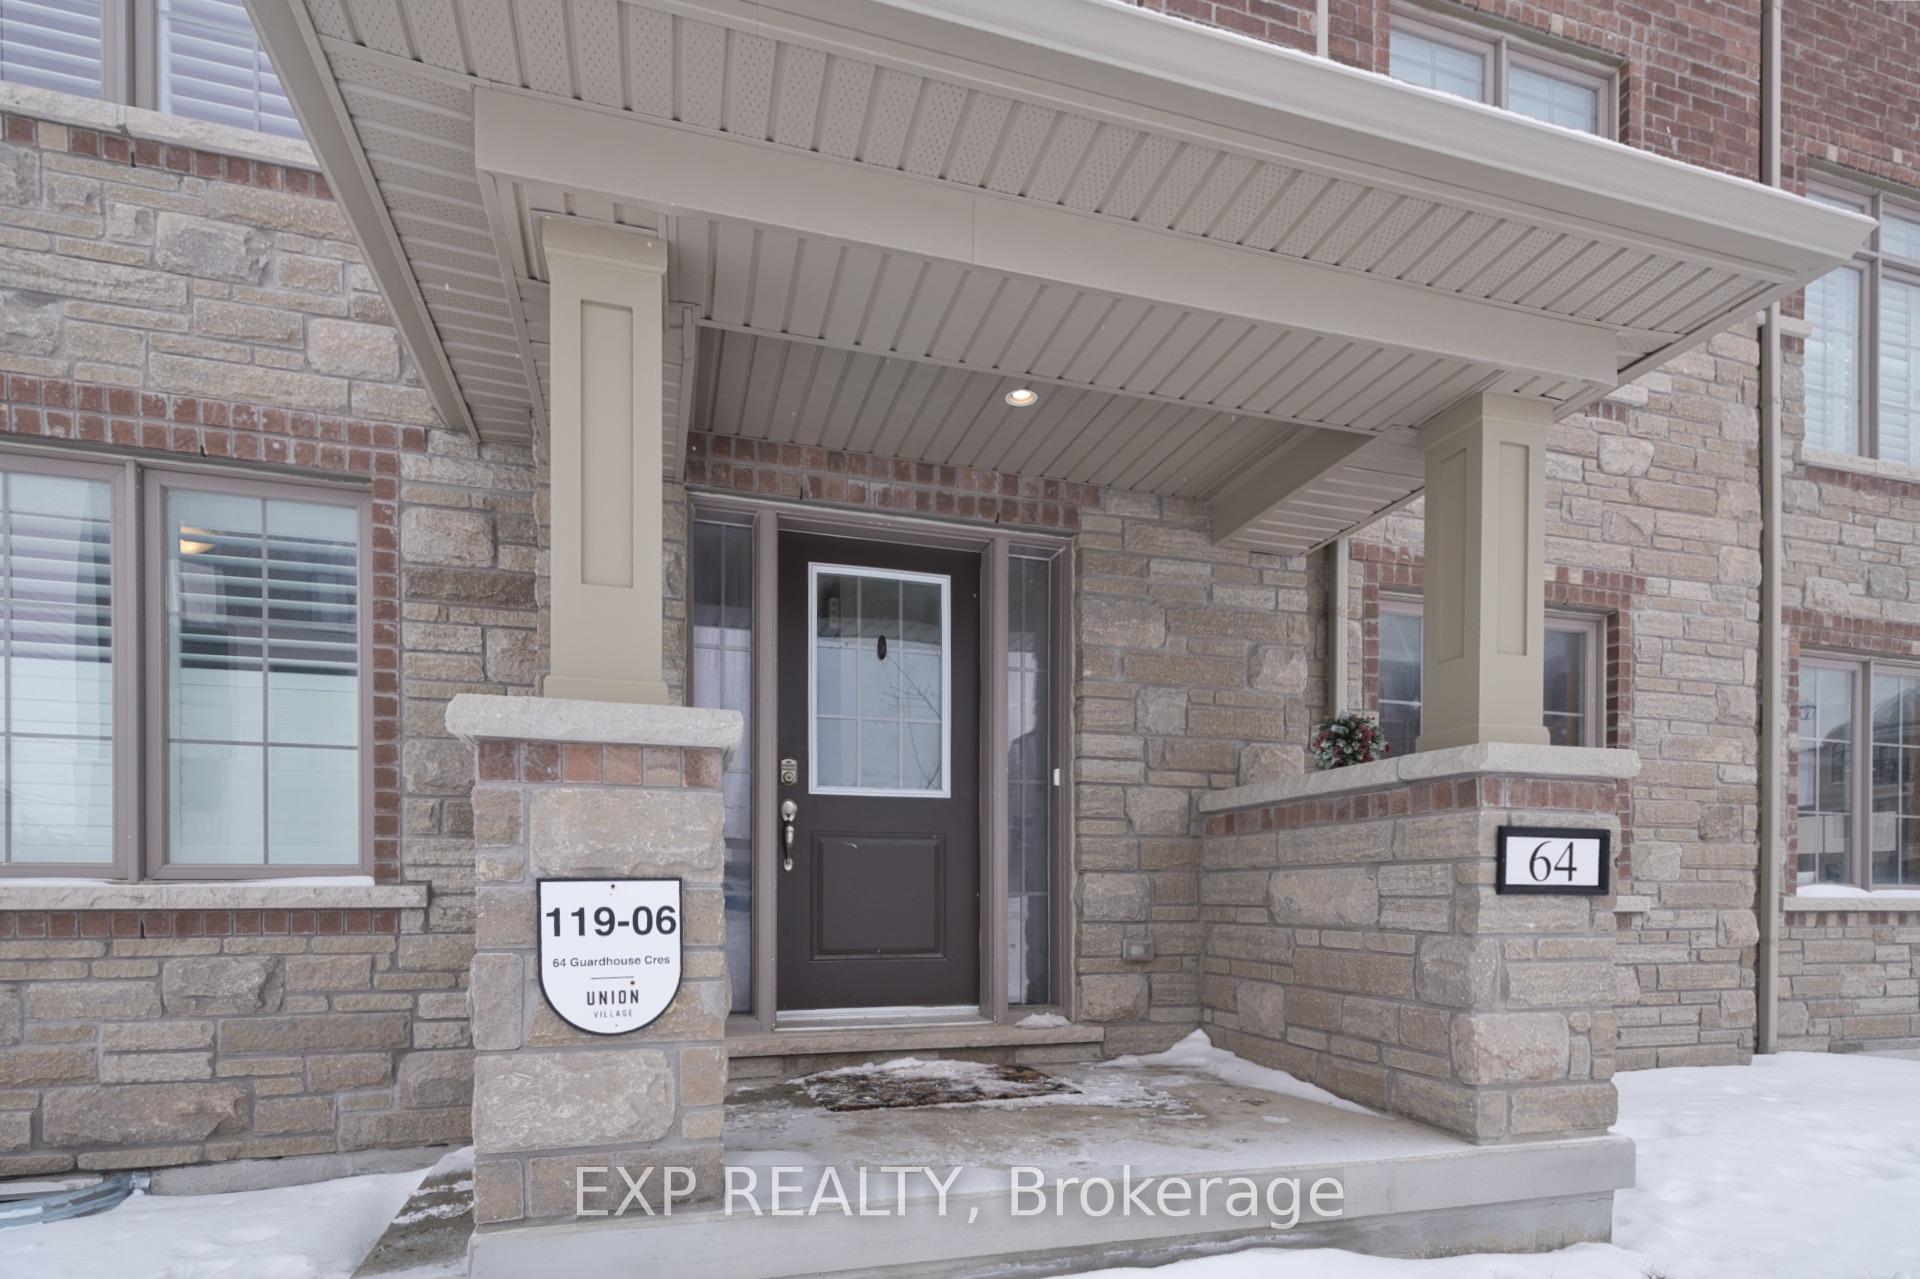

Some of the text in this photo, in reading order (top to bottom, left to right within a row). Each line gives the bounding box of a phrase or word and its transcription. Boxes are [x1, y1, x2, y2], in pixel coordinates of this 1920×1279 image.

[1529, 840, 1577, 882] 64
[546, 905, 677, 937] 119-06
[552, 955, 671, 968] 64 Guardhouse Cres
[586, 989, 639, 1006] UNION
[593, 1009, 633, 1018] VILLAGE
